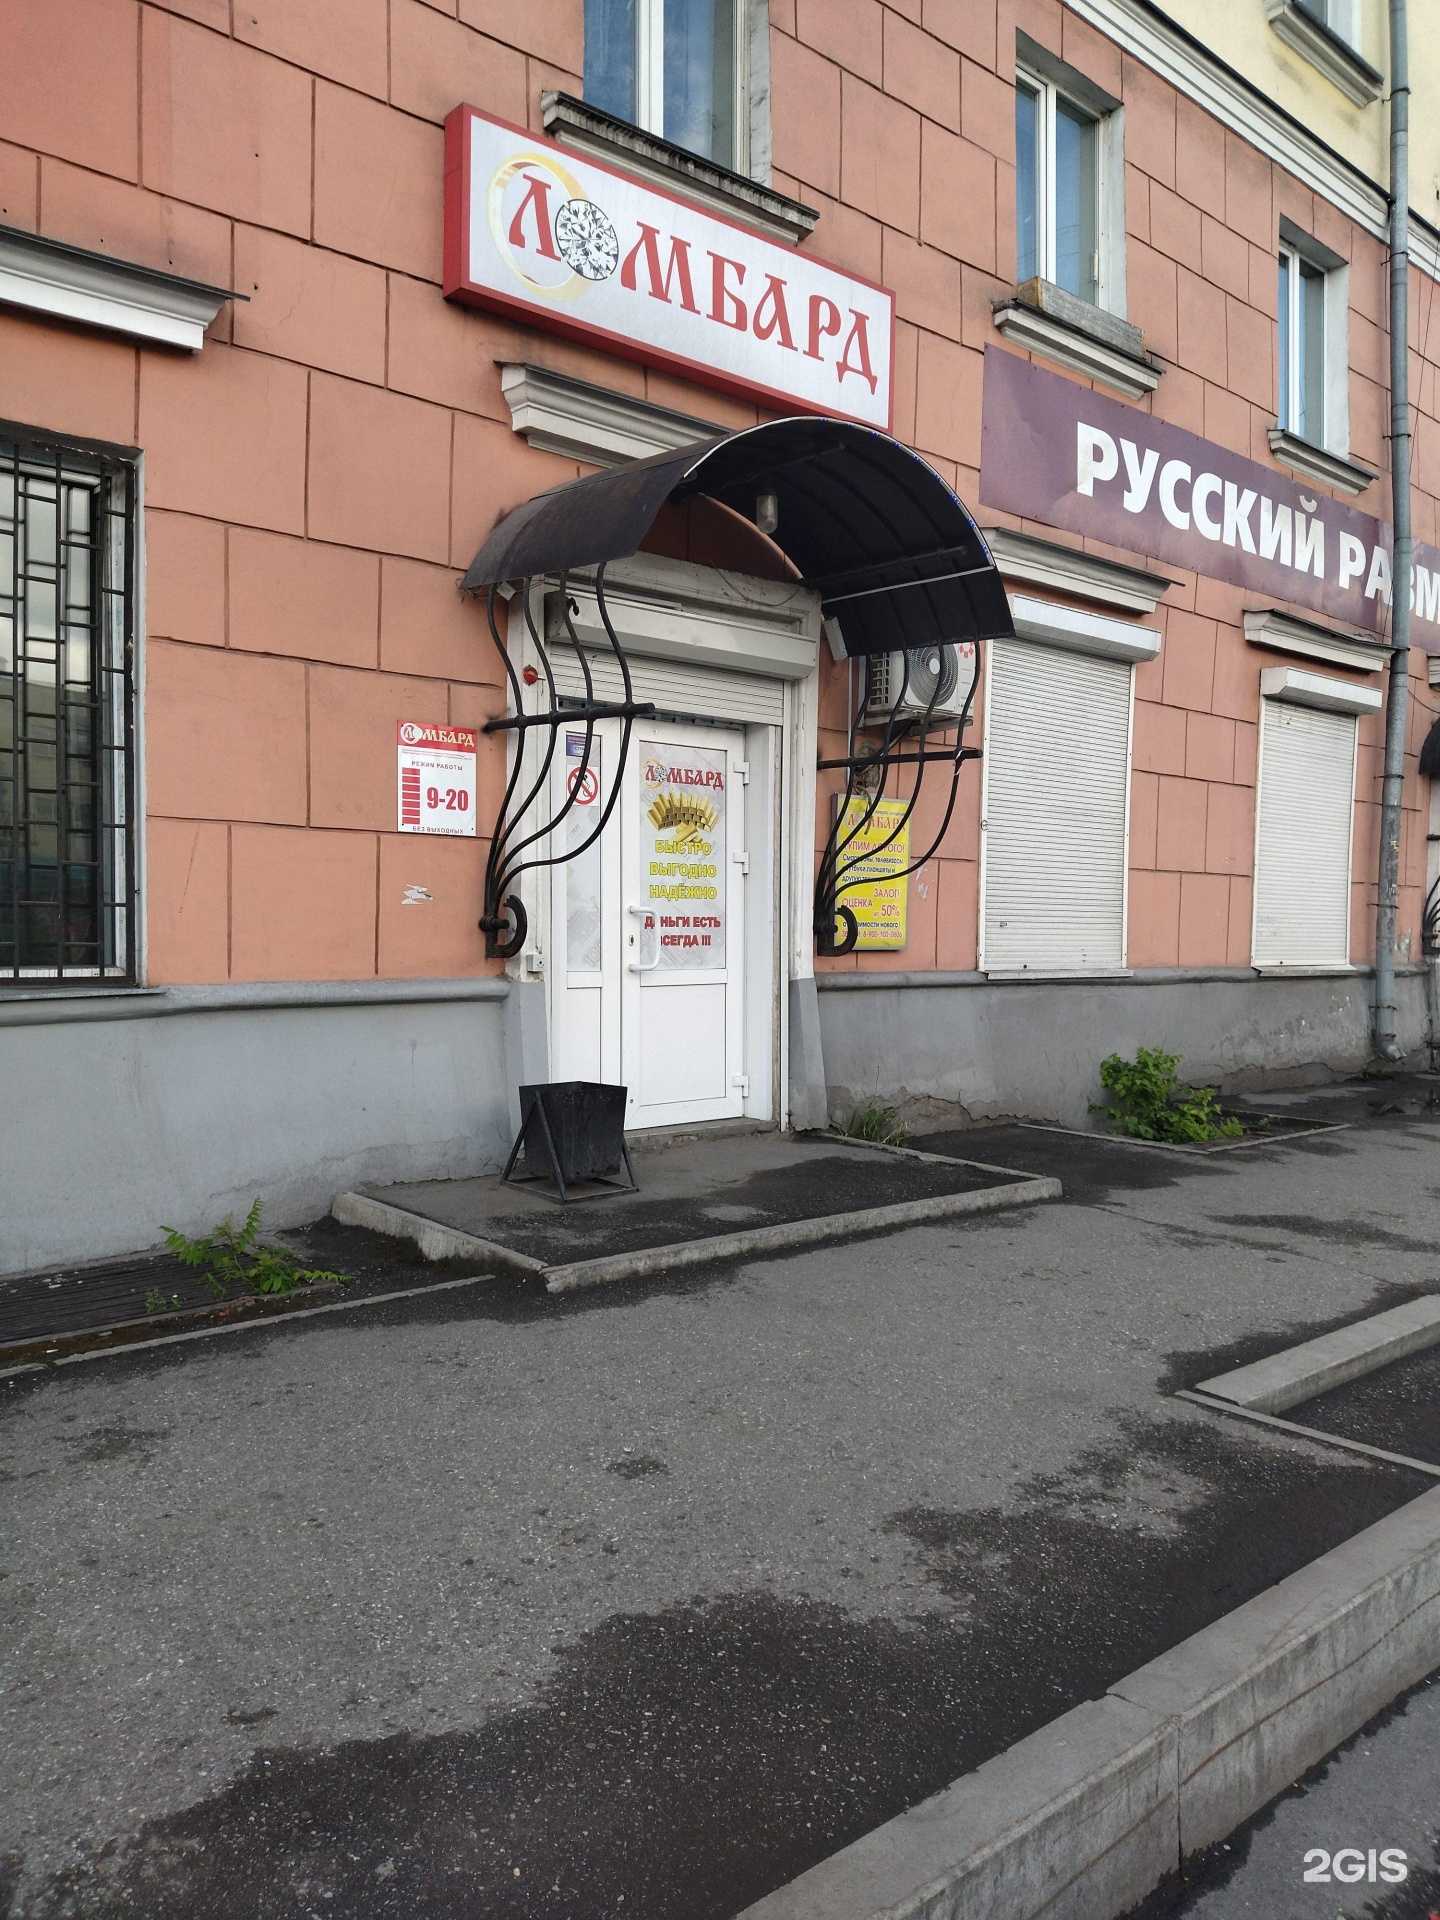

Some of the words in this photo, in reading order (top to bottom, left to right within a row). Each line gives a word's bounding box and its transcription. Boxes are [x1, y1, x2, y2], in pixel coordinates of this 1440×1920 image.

[1076, 421, 1325, 580] РУССКИЙ
[1338, 531, 1440, 625] РАМ
[427, 787, 469, 811] 9-20
[655, 839, 712, 856] БЫСТРО
[649, 862, 717, 879] ВЫГОДНО
[649, 884, 717, 901] НАДЁЖНО
[644, 916, 690, 929] ДНЬГИ
[693, 917, 721, 928] ЕСТЬ
[660, 935, 699, 948] СЕГДА
